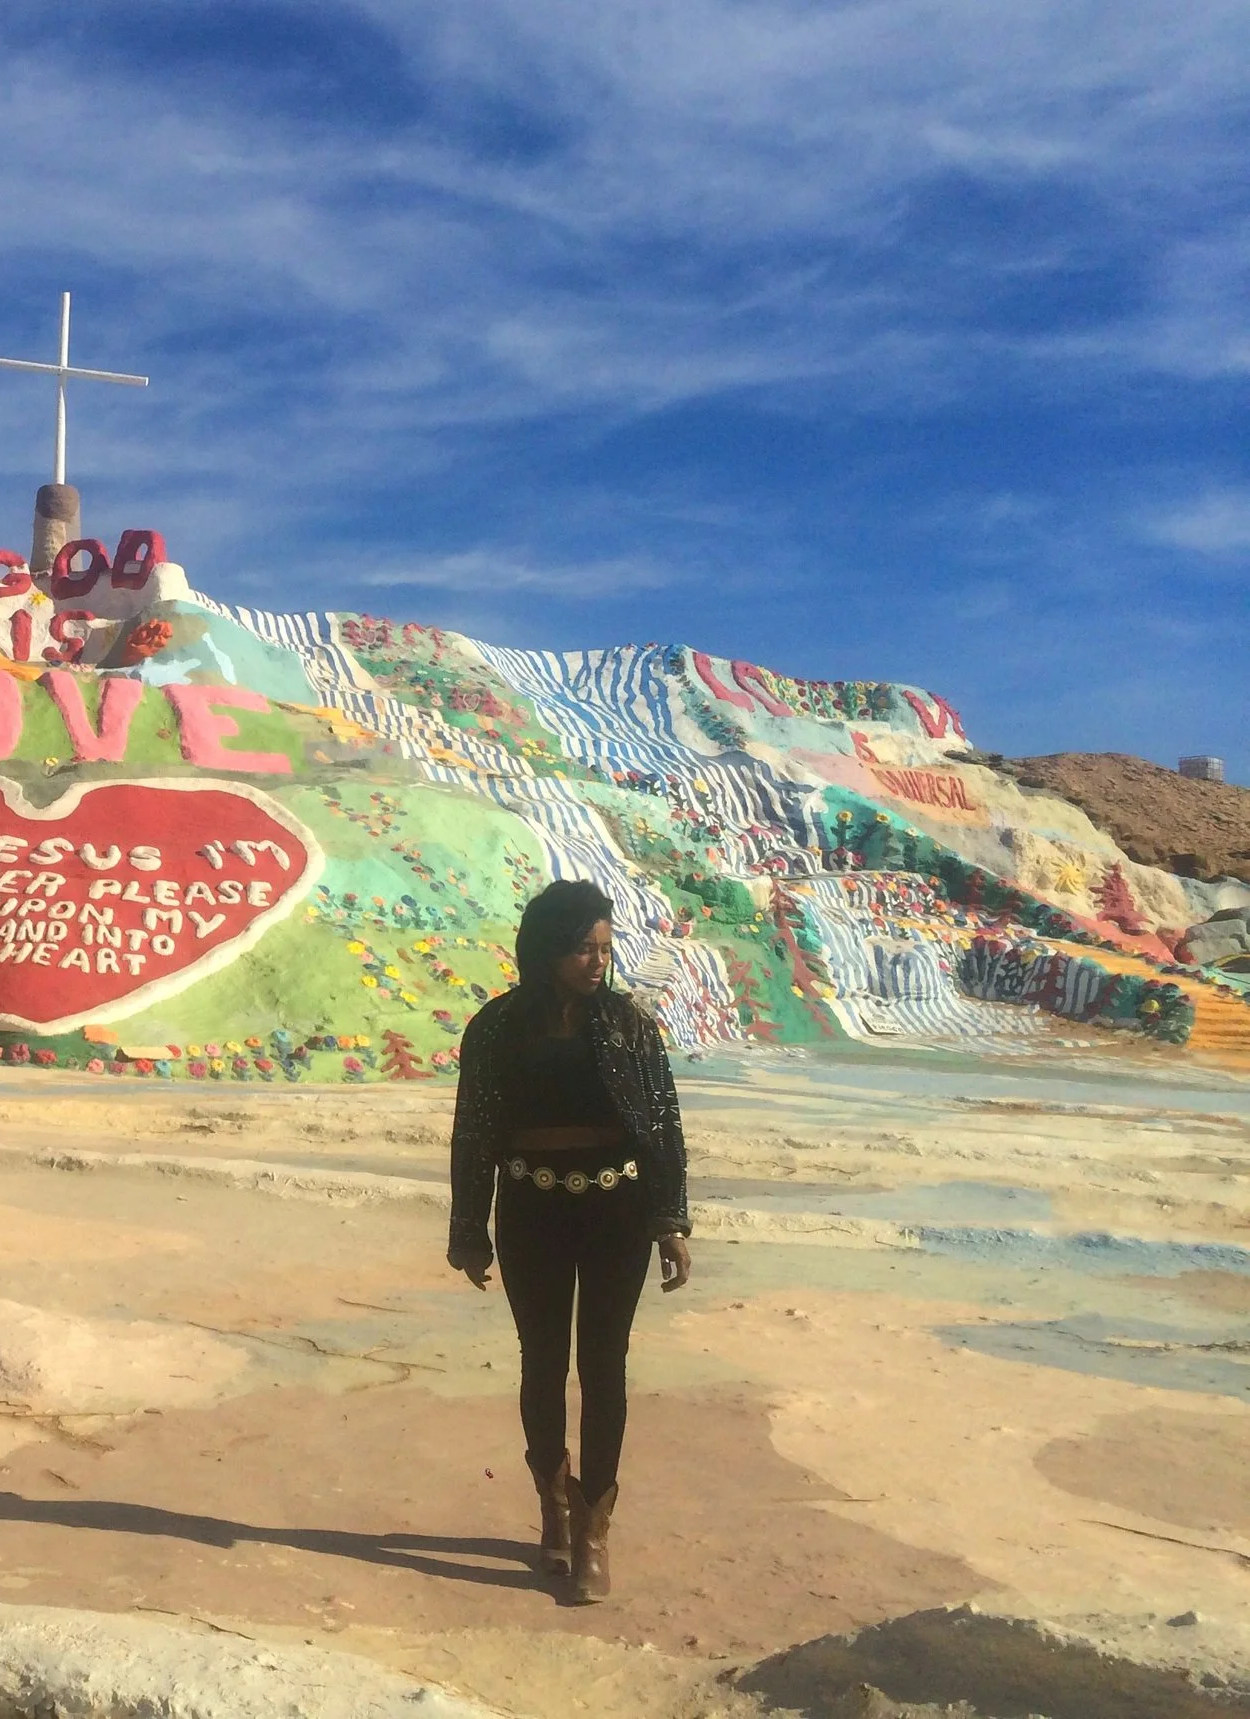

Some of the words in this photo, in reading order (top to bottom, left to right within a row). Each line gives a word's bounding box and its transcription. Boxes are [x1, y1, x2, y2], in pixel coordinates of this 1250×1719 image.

[10, 608, 96, 666] IS
[871, 766, 976, 811] UNIVERSAL
[198, 839, 291, 872] I'M
[87, 878, 273, 908] PLEASE
[81, 923, 175, 956] INTO
[142, 907, 227, 939] MY
